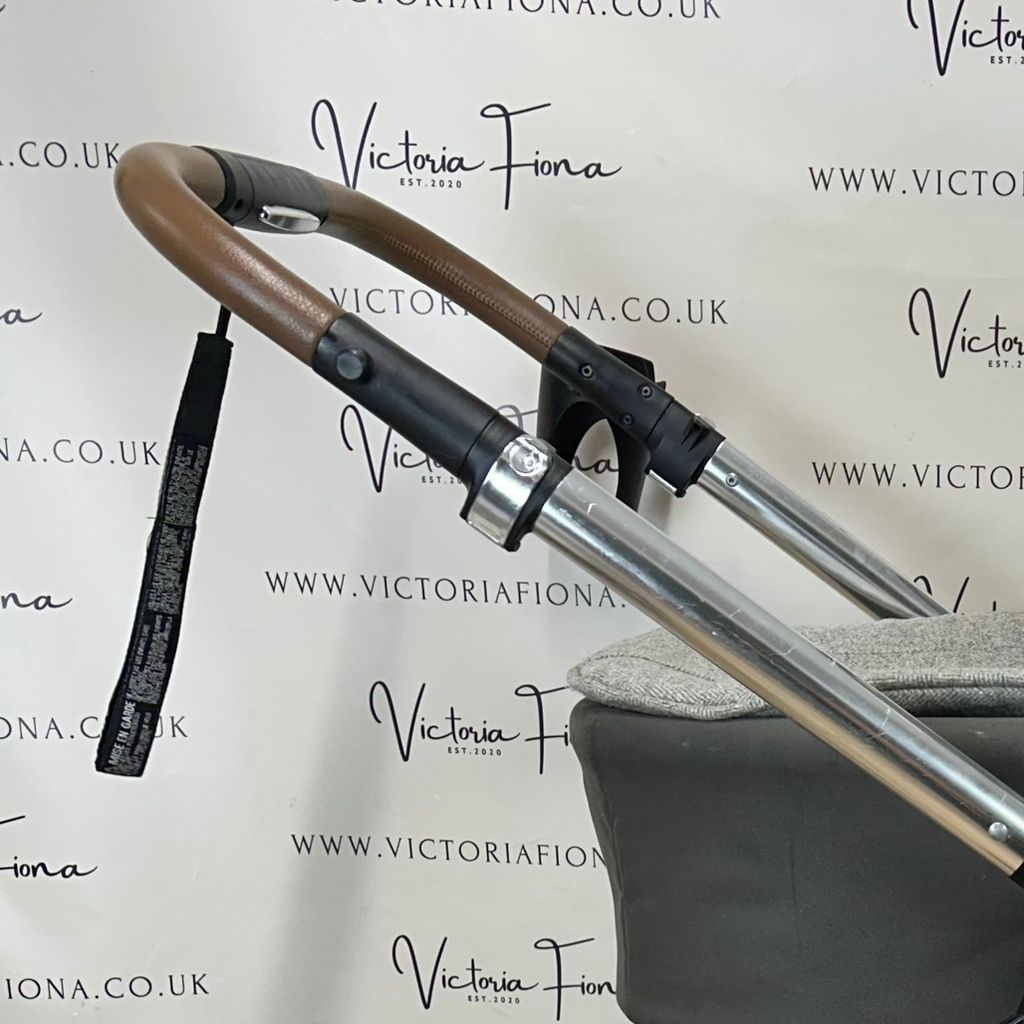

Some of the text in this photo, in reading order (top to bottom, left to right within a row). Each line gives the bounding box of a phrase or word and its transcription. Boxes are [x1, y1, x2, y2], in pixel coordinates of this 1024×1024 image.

[0, 141, 119, 169] .CO.UK
[311, 99, 622, 210] Victoria Fiona
[400, 177, 462, 188] EST.2020
[369, 681, 521, 762] Victoria
[447, 746, 502, 756] EST.2020
[392, 934, 539, 1010] Victoria
[468, 995, 520, 1005] EST.2020
